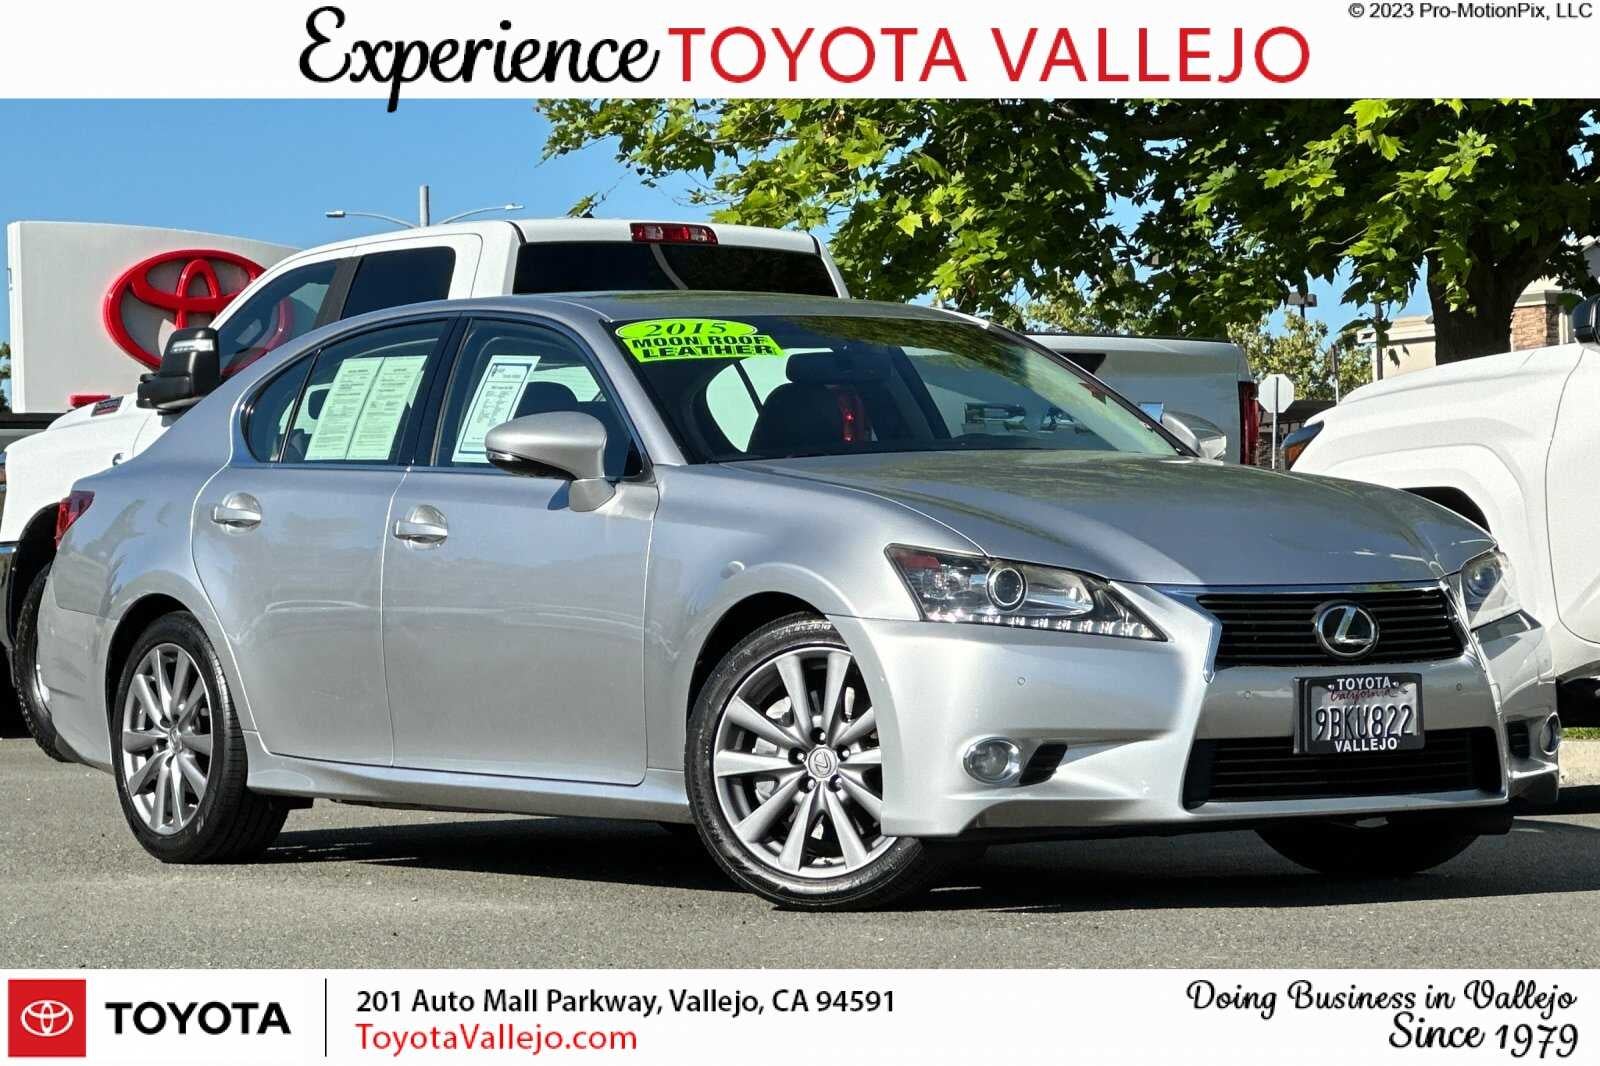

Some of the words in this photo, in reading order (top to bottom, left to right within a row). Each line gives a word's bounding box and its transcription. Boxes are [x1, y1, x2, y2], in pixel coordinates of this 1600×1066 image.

[643, 322, 727, 337] 2015
[632, 337, 701, 348] MOON
[708, 335, 767, 345] ROOF
[642, 346, 774, 358] LEATHER
[1337, 676, 1391, 690] TOYOTA
[1334, 738, 1398, 752] VALLEJO
